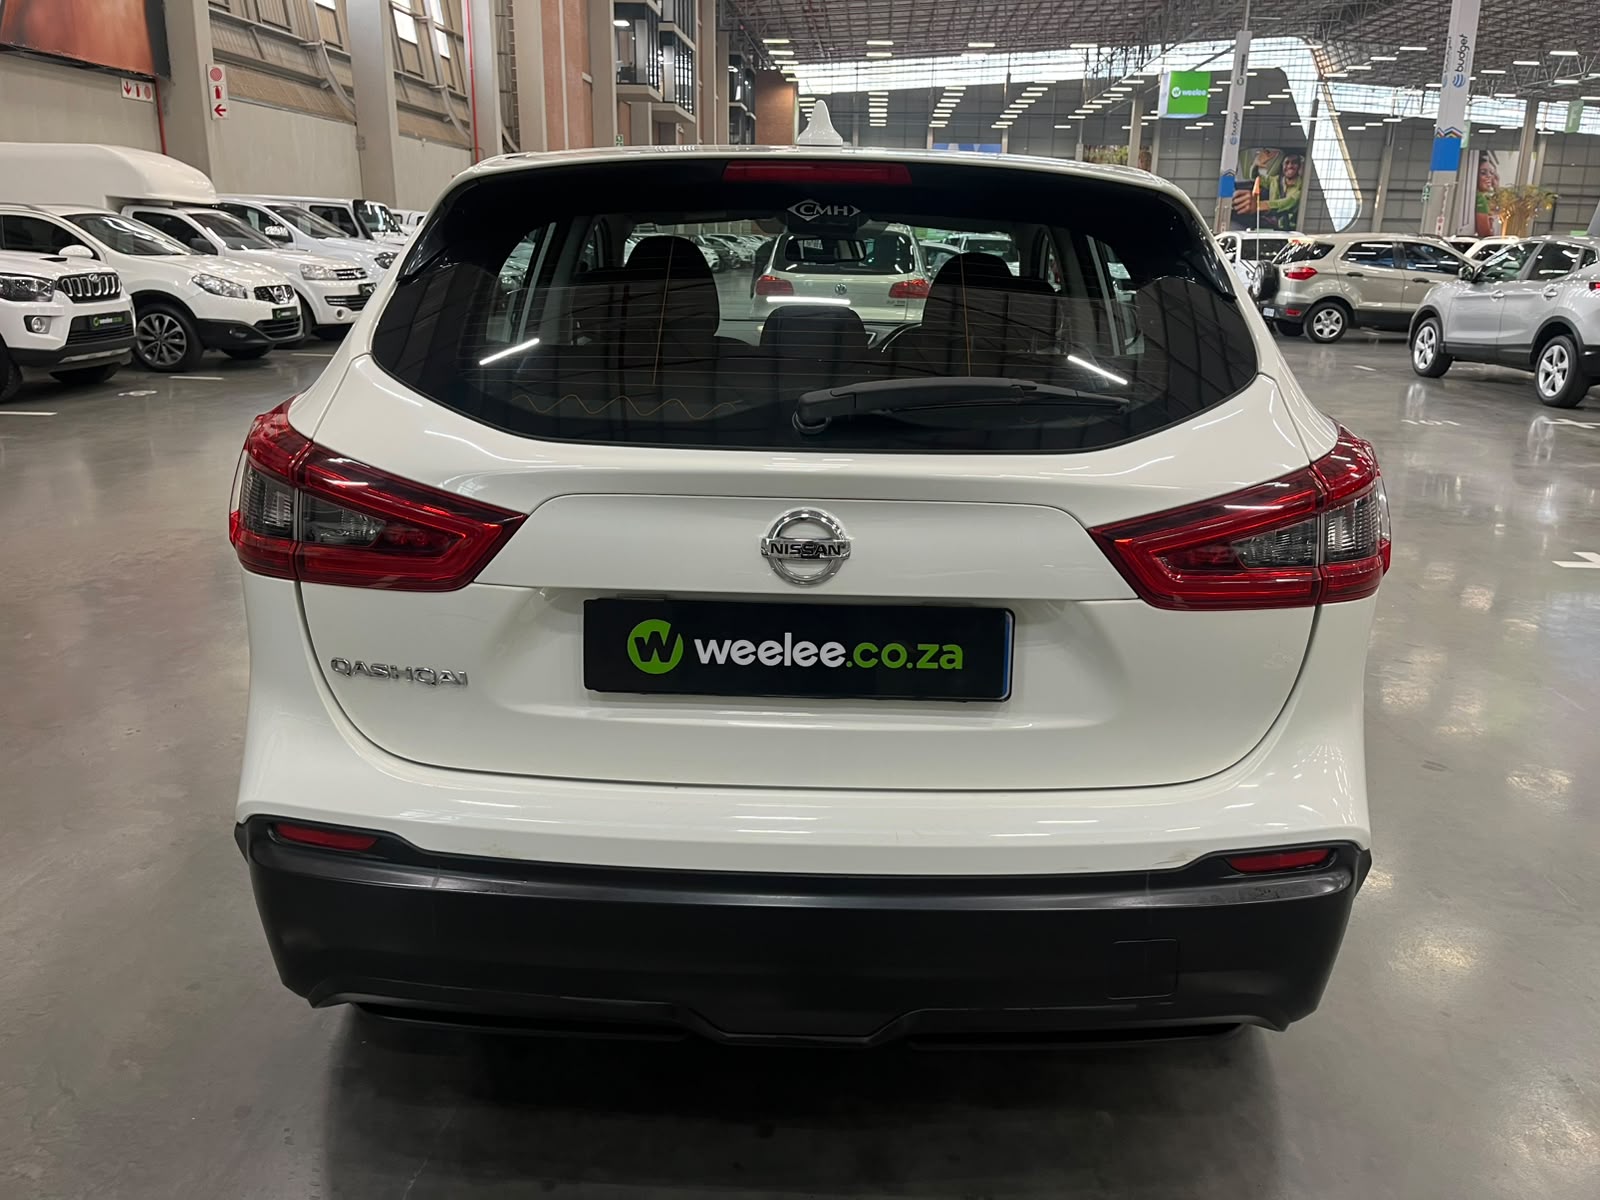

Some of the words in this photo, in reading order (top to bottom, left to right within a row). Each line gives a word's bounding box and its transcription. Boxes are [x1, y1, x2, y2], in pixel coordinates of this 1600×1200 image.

[1454, 33, 1470, 73] budget
[799, 203, 849, 217] CMH
[770, 541, 842, 556] NISSAN
[694, 632, 964, 671] weelee.co.za
[330, 656, 469, 687] QASHQAI
